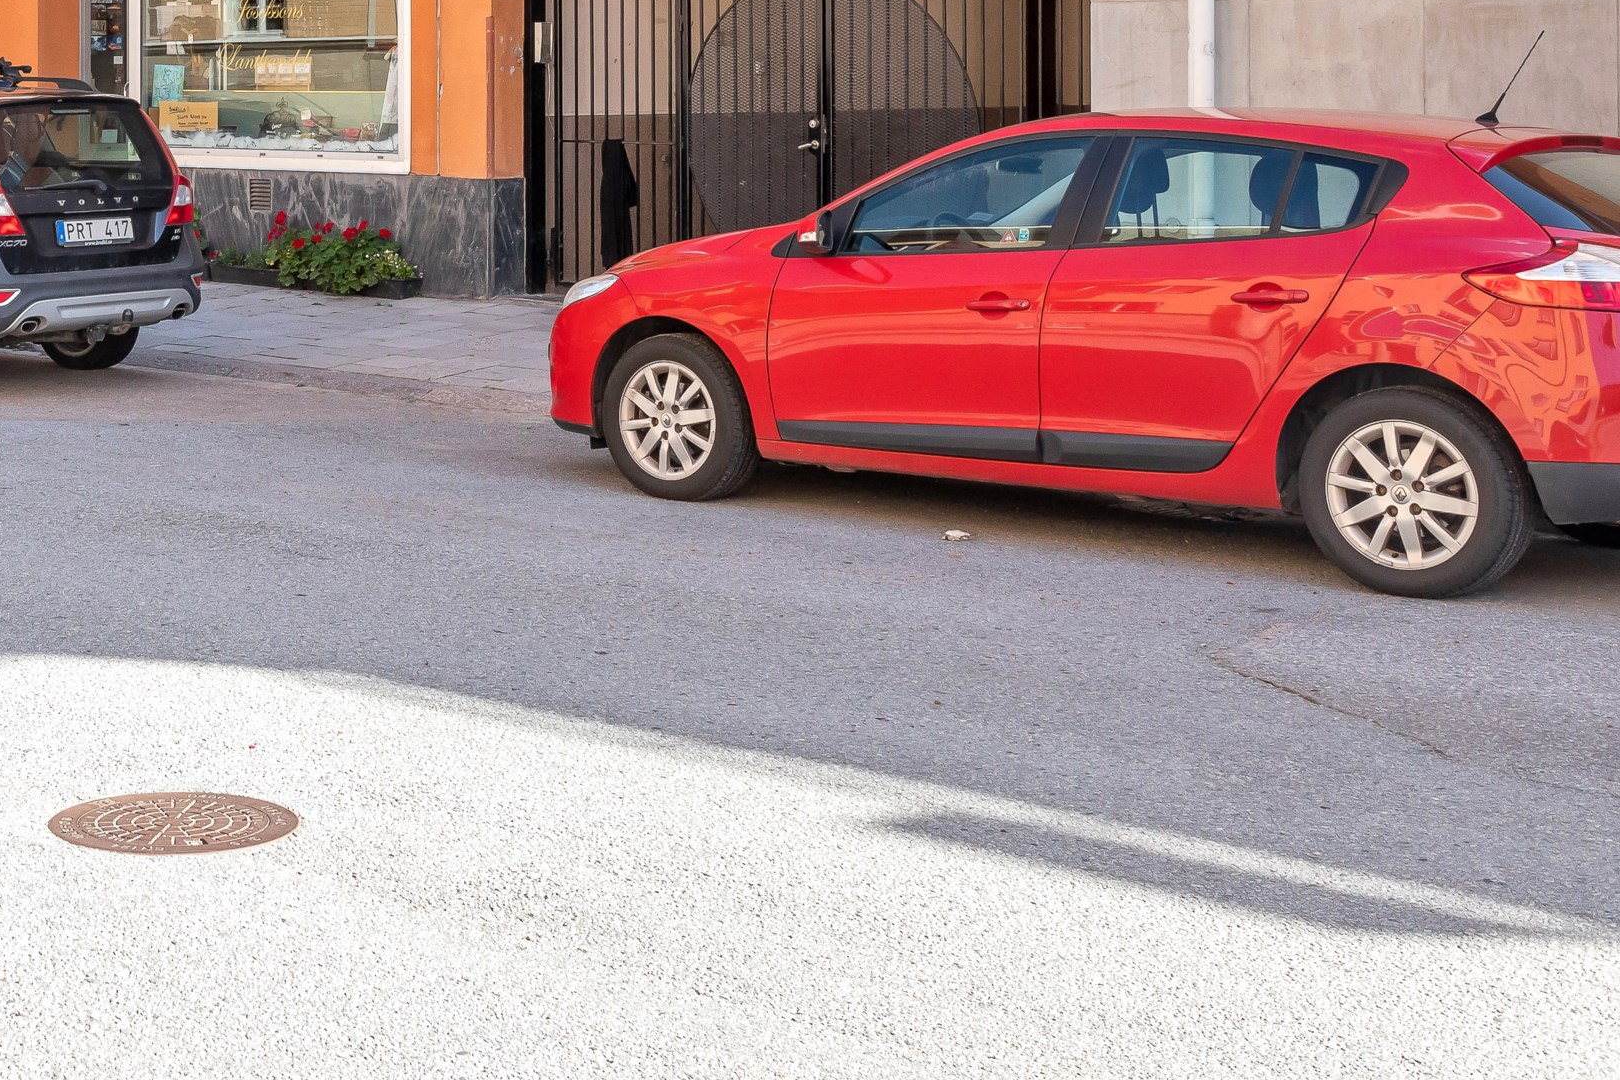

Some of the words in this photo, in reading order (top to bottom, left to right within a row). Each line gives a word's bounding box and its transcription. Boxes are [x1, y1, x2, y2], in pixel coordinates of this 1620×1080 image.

[57, 195, 139, 207] VOLVO
[66, 221, 94, 240] PRT
[105, 219, 130, 237] 417
